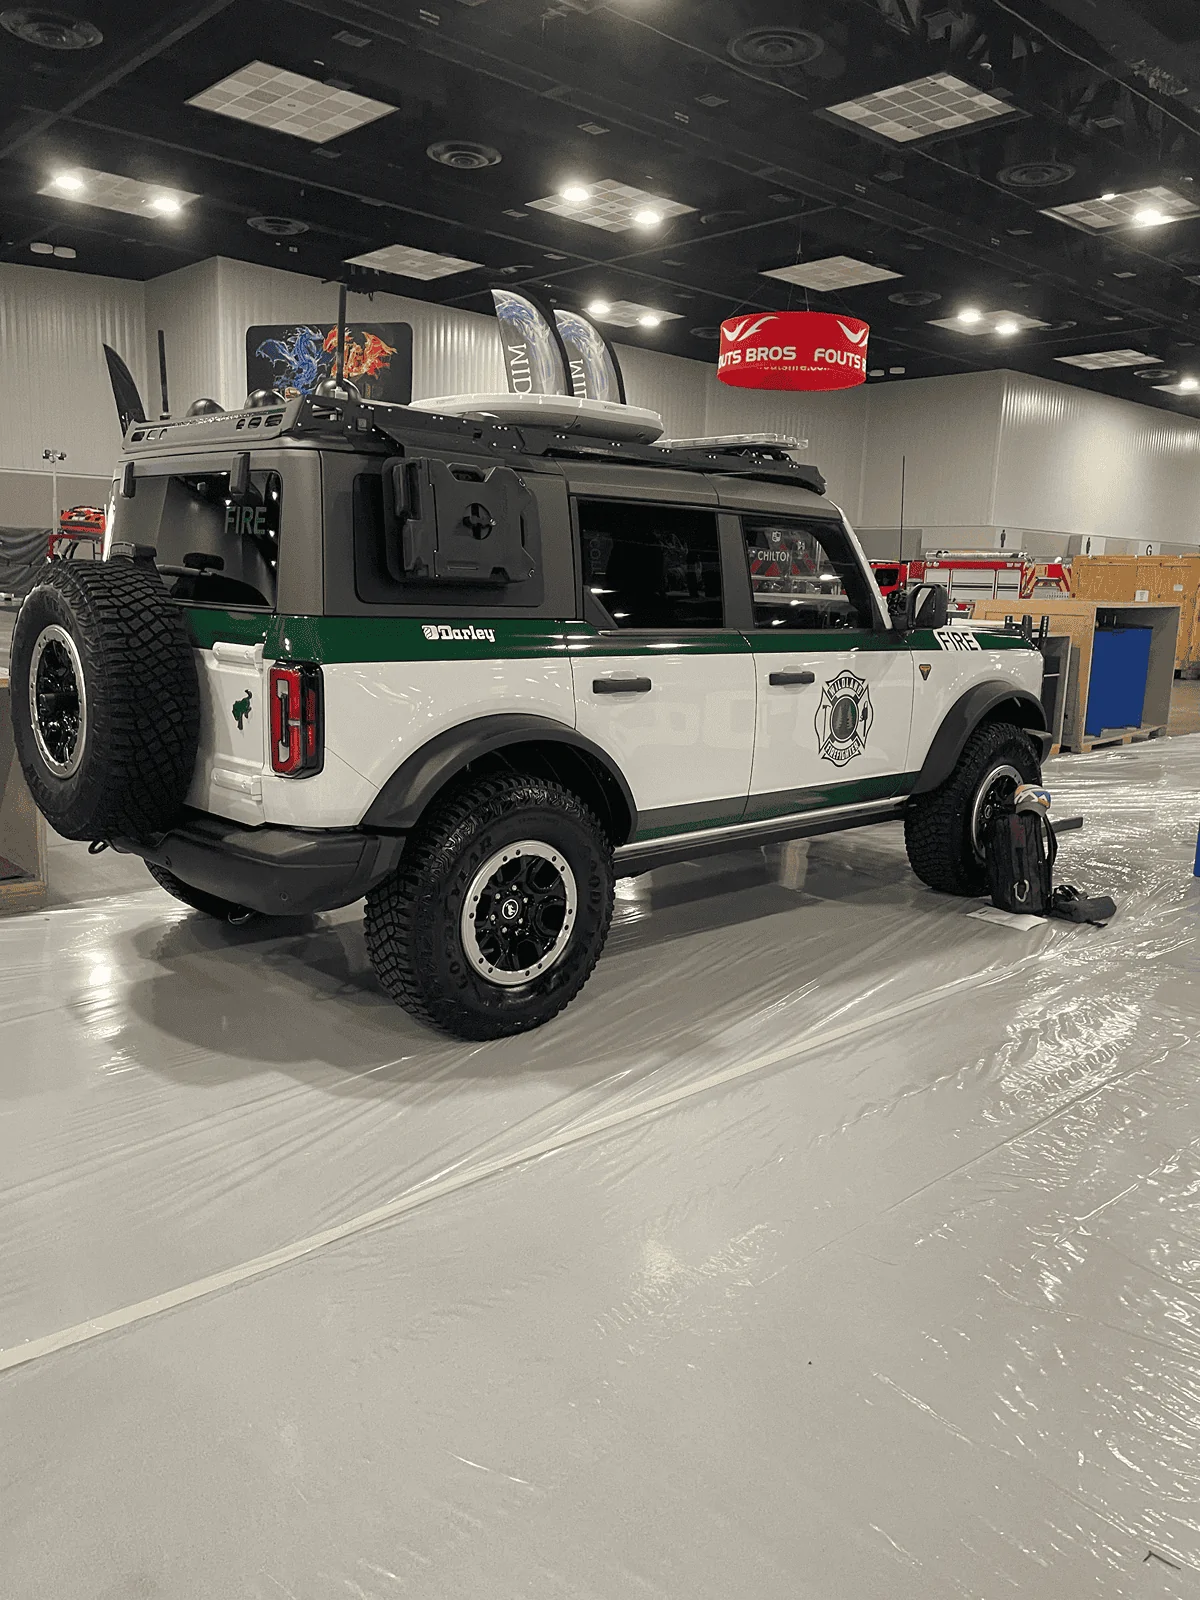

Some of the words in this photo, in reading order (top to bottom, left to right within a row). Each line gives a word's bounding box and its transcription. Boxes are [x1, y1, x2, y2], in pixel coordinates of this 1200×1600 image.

[745, 346, 797, 362] BROS
[814, 347, 861, 368] FOUTS
[224, 506, 267, 534] FIRE
[437, 625, 496, 643] Darley
[936, 631, 979, 651] FIRE
[828, 677, 863, 697] WILDLAND
